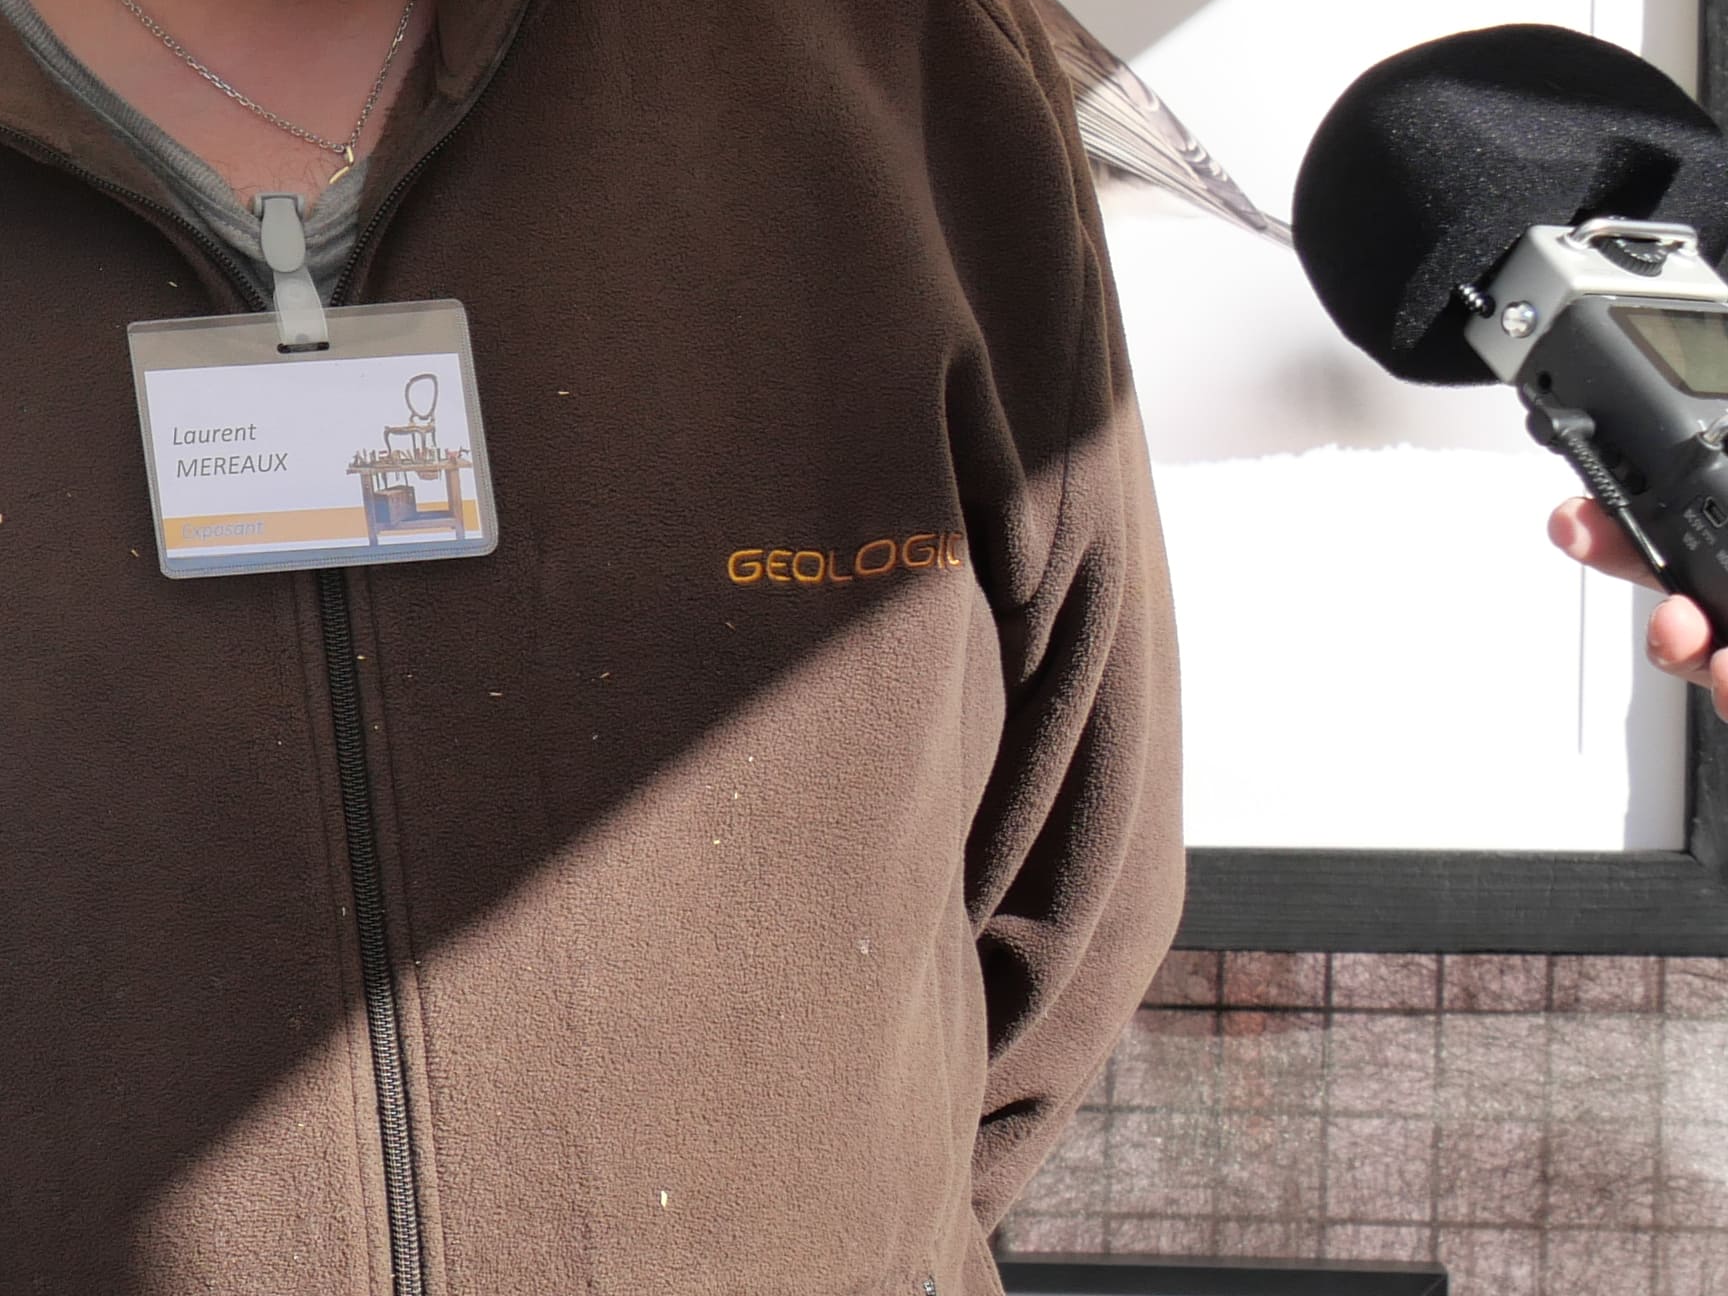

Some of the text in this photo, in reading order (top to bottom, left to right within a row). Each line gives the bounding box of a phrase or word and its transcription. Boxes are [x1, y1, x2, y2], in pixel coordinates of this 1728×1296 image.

[172, 423, 257, 446] Laurent
[176, 452, 289, 478] MEREAUX
[182, 520, 265, 541] Exposant
